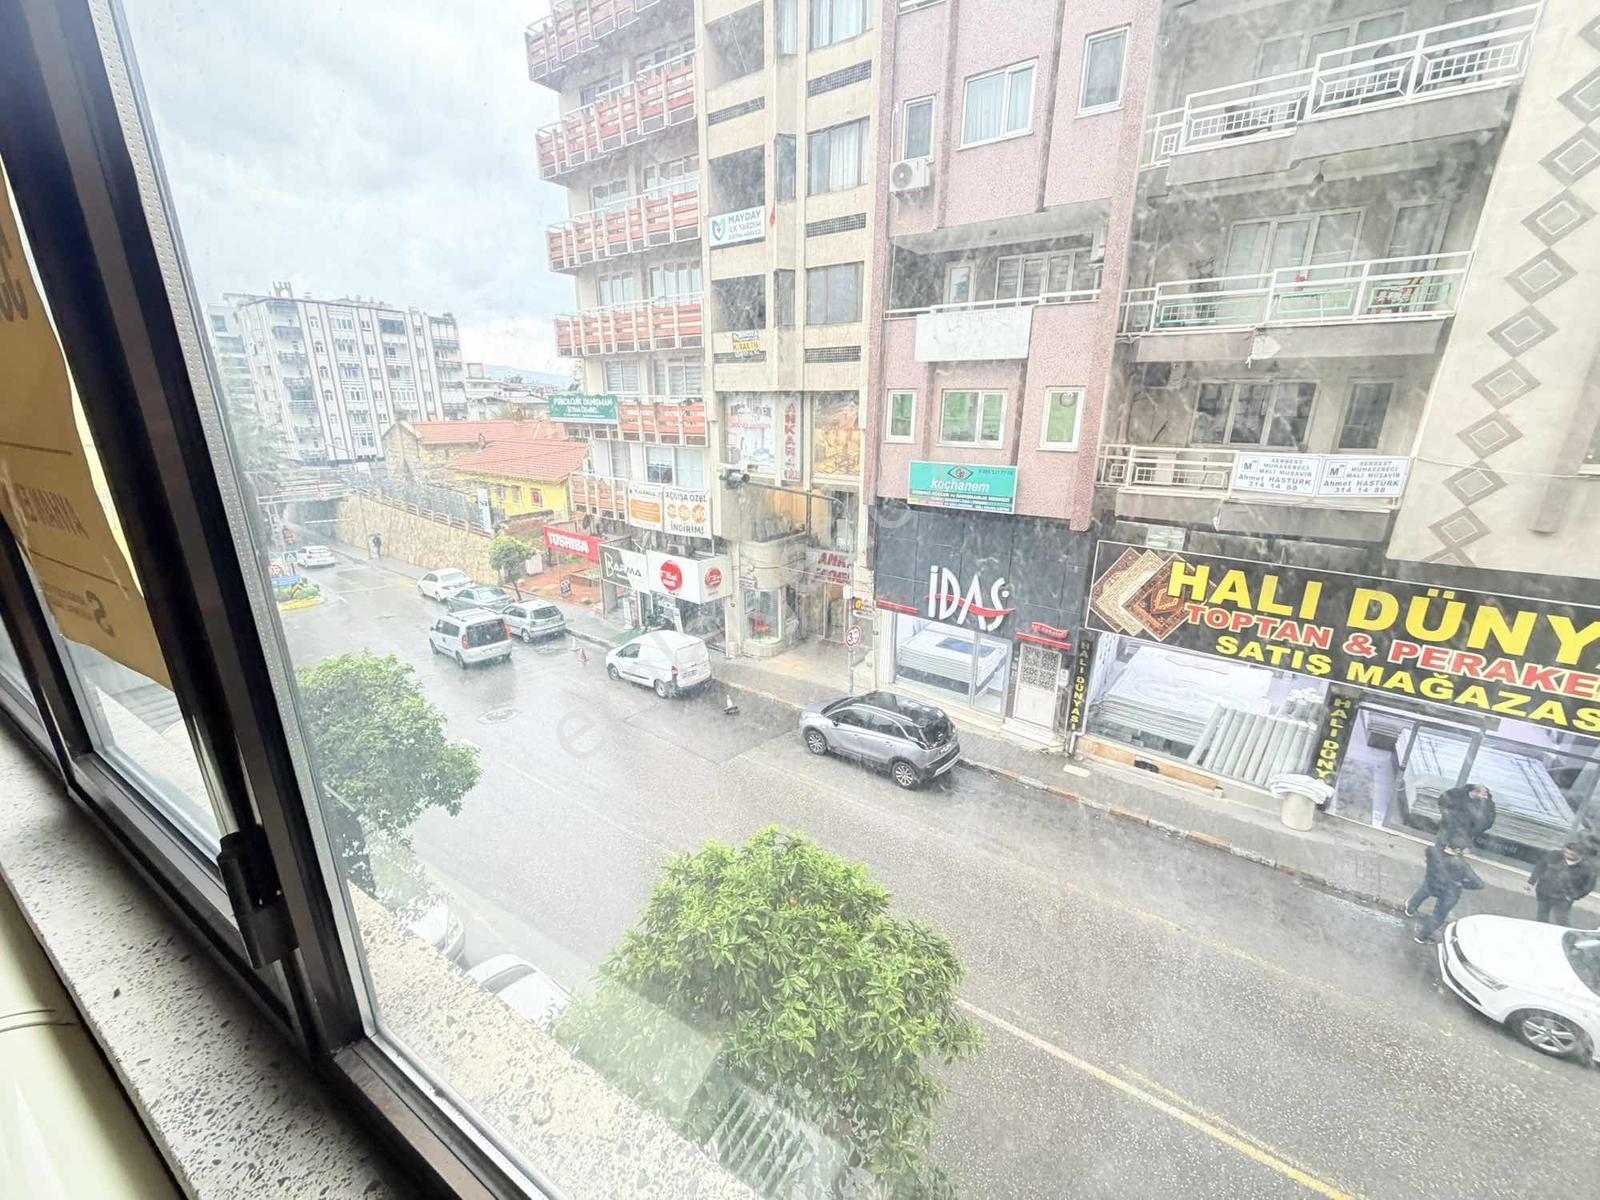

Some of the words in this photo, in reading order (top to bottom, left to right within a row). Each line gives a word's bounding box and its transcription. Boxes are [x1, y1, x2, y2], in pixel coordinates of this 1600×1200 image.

[728, 209, 761, 225] MAYDAY
[1238, 473, 1264, 481] Ahmet
[1268, 475, 1312, 486] HASTÜRK
[1323, 479, 1352, 487] Ahmet
[1355, 479, 1400, 487] HASTÜRK
[547, 531, 589, 554] TOSHIBA
[1167, 560, 1324, 619] HALI
[1346, 587, 1600, 669] DÜNY
[1079, 641, 1090, 674] HALI
[1184, 601, 1335, 650] TOPTAN
[1343, 633, 1377, 659] &
[1387, 641, 1600, 702] PERAKE
[1216, 635, 1334, 676] SATIŞ
[1329, 698, 1352, 737] HALI
